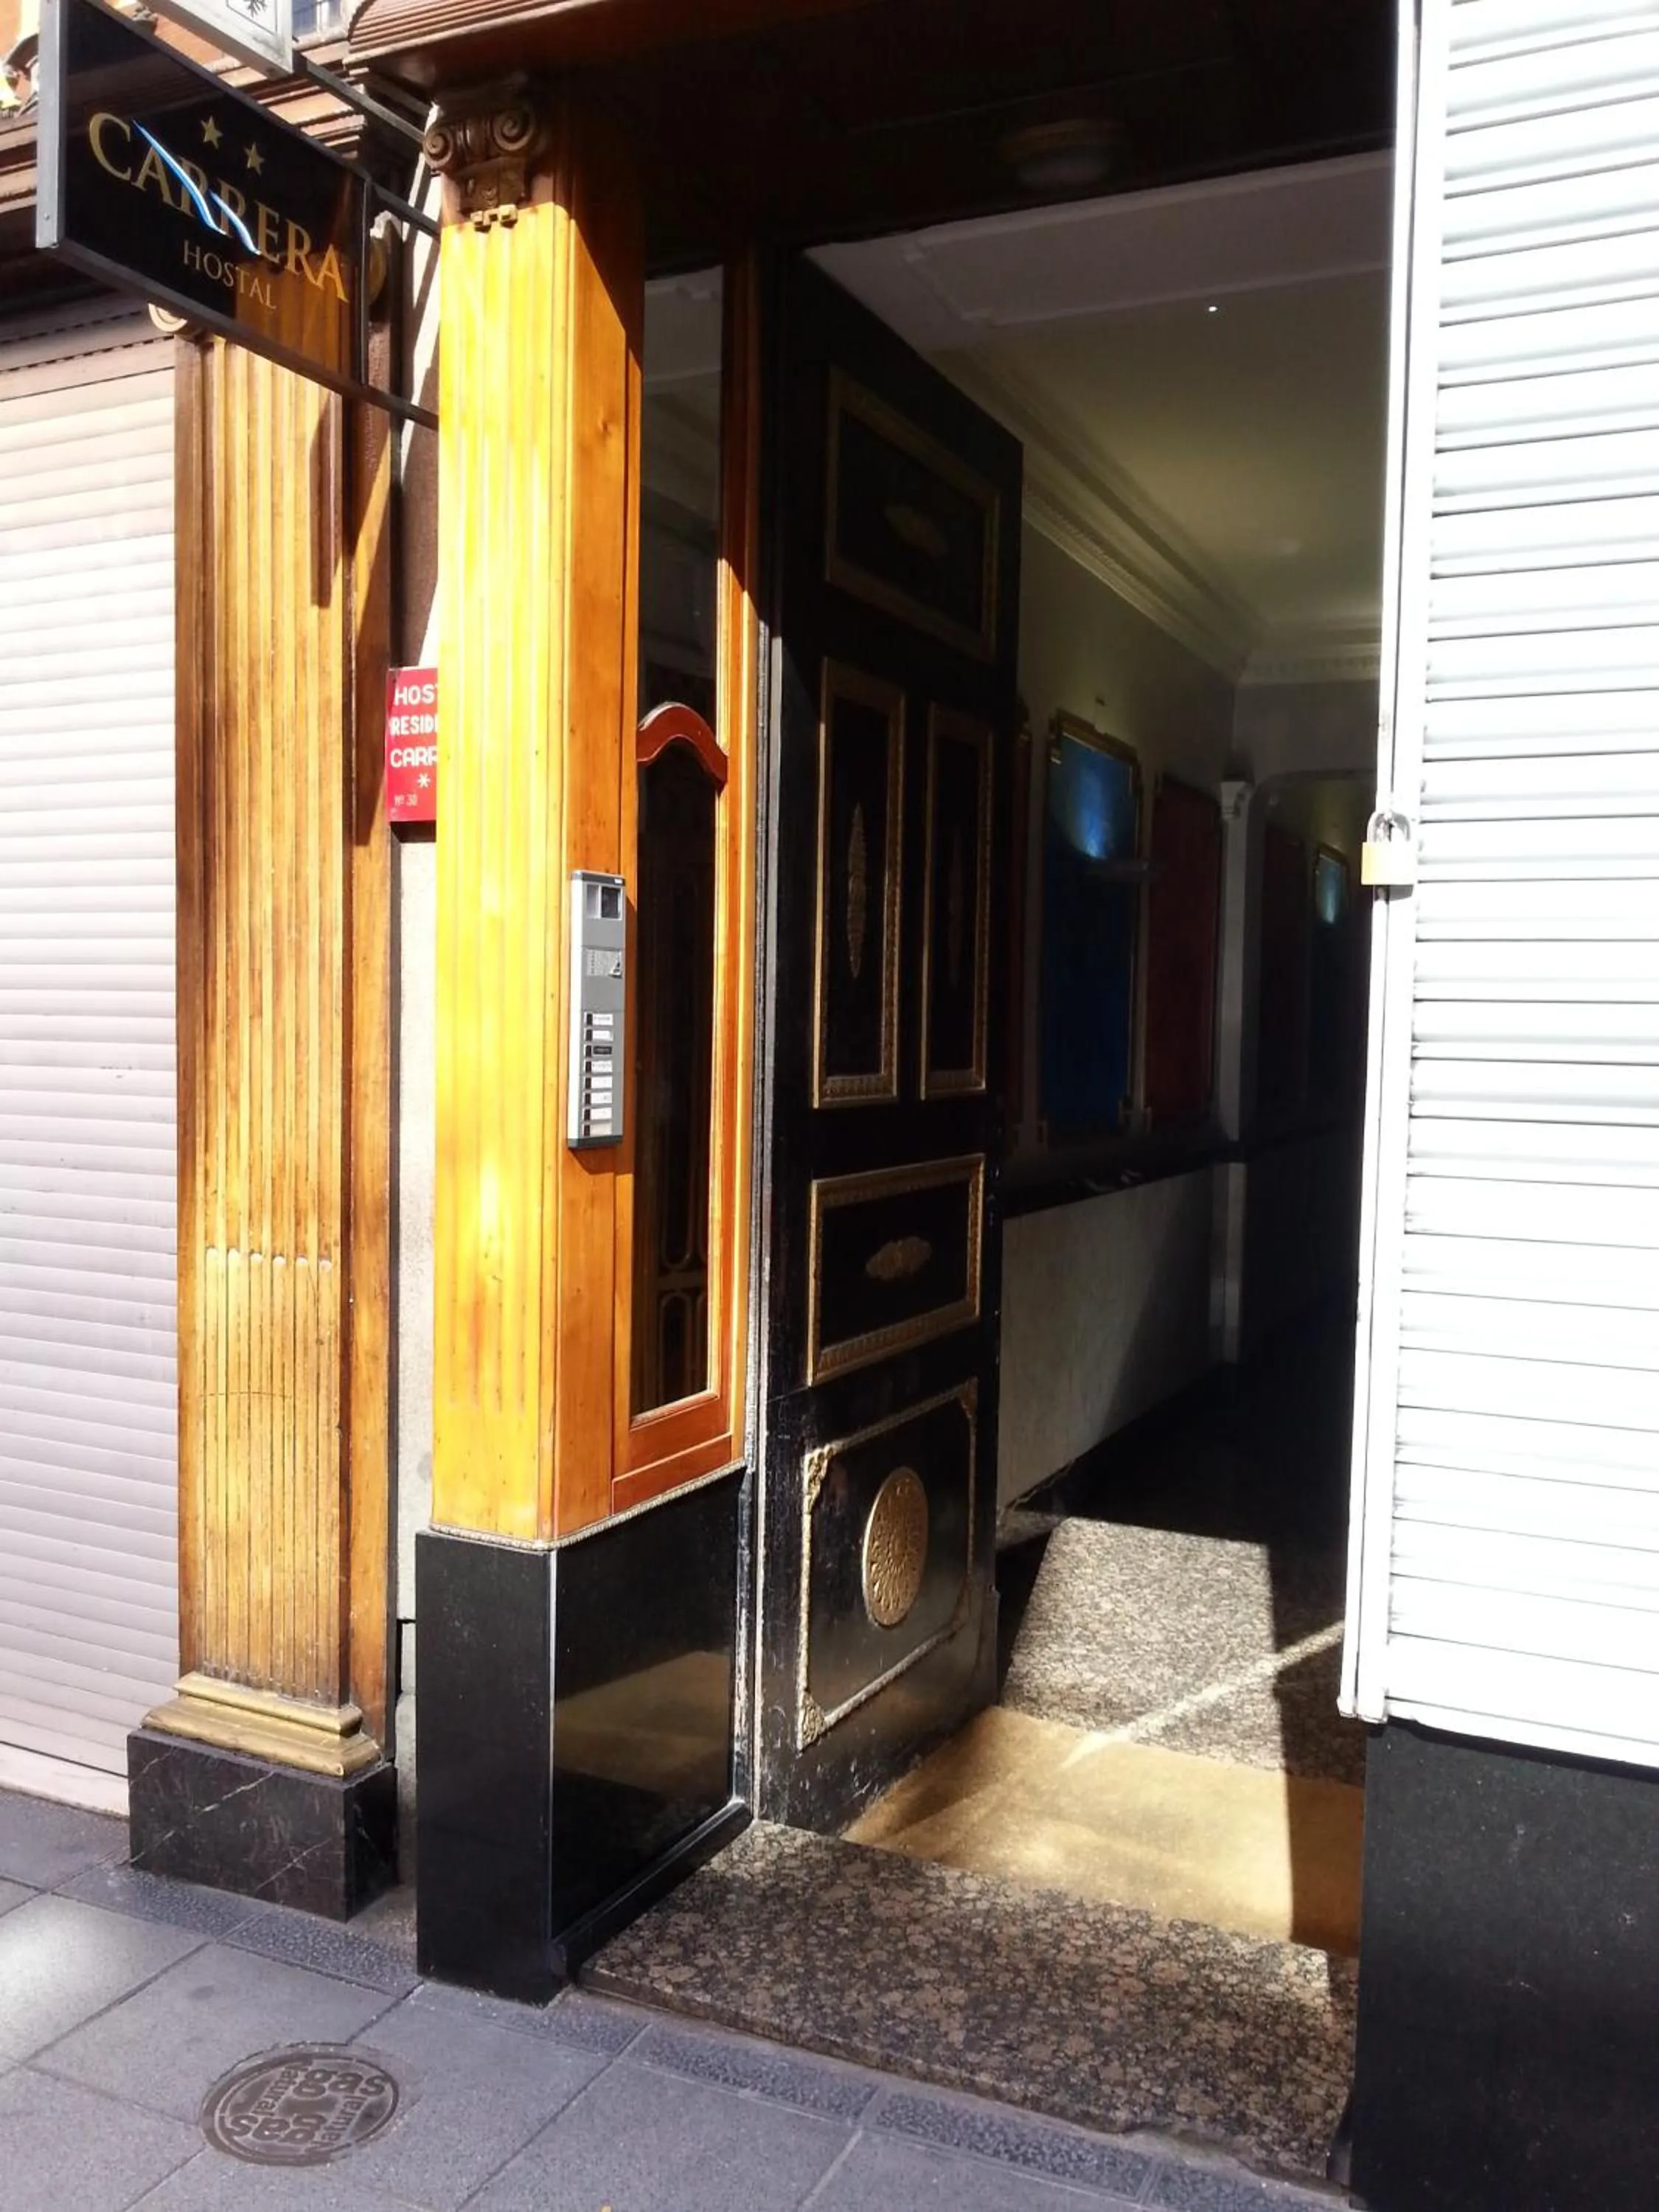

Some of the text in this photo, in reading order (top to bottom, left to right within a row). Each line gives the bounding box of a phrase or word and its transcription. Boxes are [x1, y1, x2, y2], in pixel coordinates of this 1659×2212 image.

[89, 112, 349, 304] CARRERA
[184, 240, 277, 309] HOSTAL
[293, 2068, 387, 2098] gas
